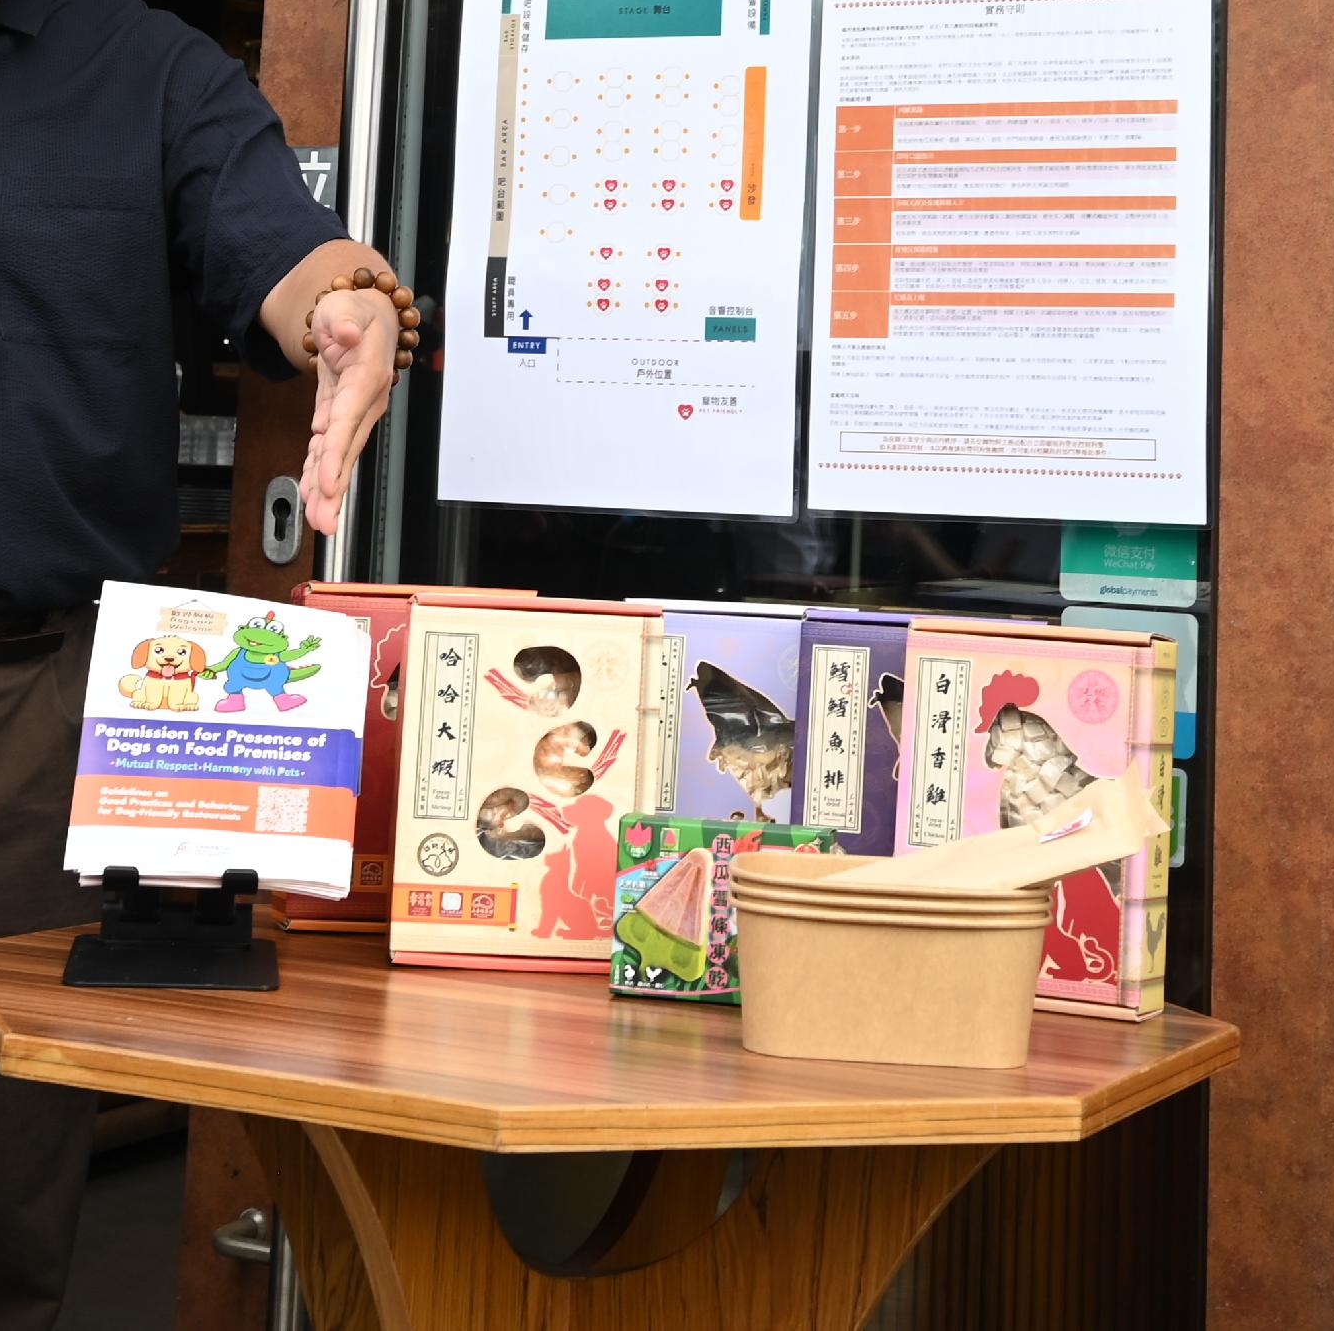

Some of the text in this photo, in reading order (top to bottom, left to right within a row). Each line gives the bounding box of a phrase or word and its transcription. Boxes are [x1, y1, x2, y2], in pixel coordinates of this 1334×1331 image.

[654, 6, 670, 14] 舞台
[986, 4, 1025, 15] 實務守則
[713, 325, 748, 333] PANELS
[513, 342, 541, 350] ENTRY
[519, 359, 535, 368] 入口
[631, 358, 679, 366] OUTDOOR
[636, 369, 672, 379] 戶外位置
[702, 397, 737, 406] 寵物友善
[1104, 544, 1155, 559] 微信支付
[1104, 559, 1155, 572] WeChat Pay
[1100, 586, 1158, 597] globalpayments
[432, 648, 462, 778] 哈哈大蝦
[824, 662, 850, 790] 鱈鱈魚排
[95, 724, 327, 748] Permission for Presence of
[925, 674, 952, 806] 白滑香雞
[107, 739, 311, 761] Dogs on Food Premises
[116, 758, 154, 769] Mutual
[254, 767, 275, 775] with
[278, 767, 299, 777] Pets
[100, 787, 152, 797] Guidelines
[99, 797, 249, 812] Good Practices and Behaviour
[98, 807, 241, 821] for Dog-friendly Restaurants
[708, 837, 732, 988] 西瓜雪條凍乾
